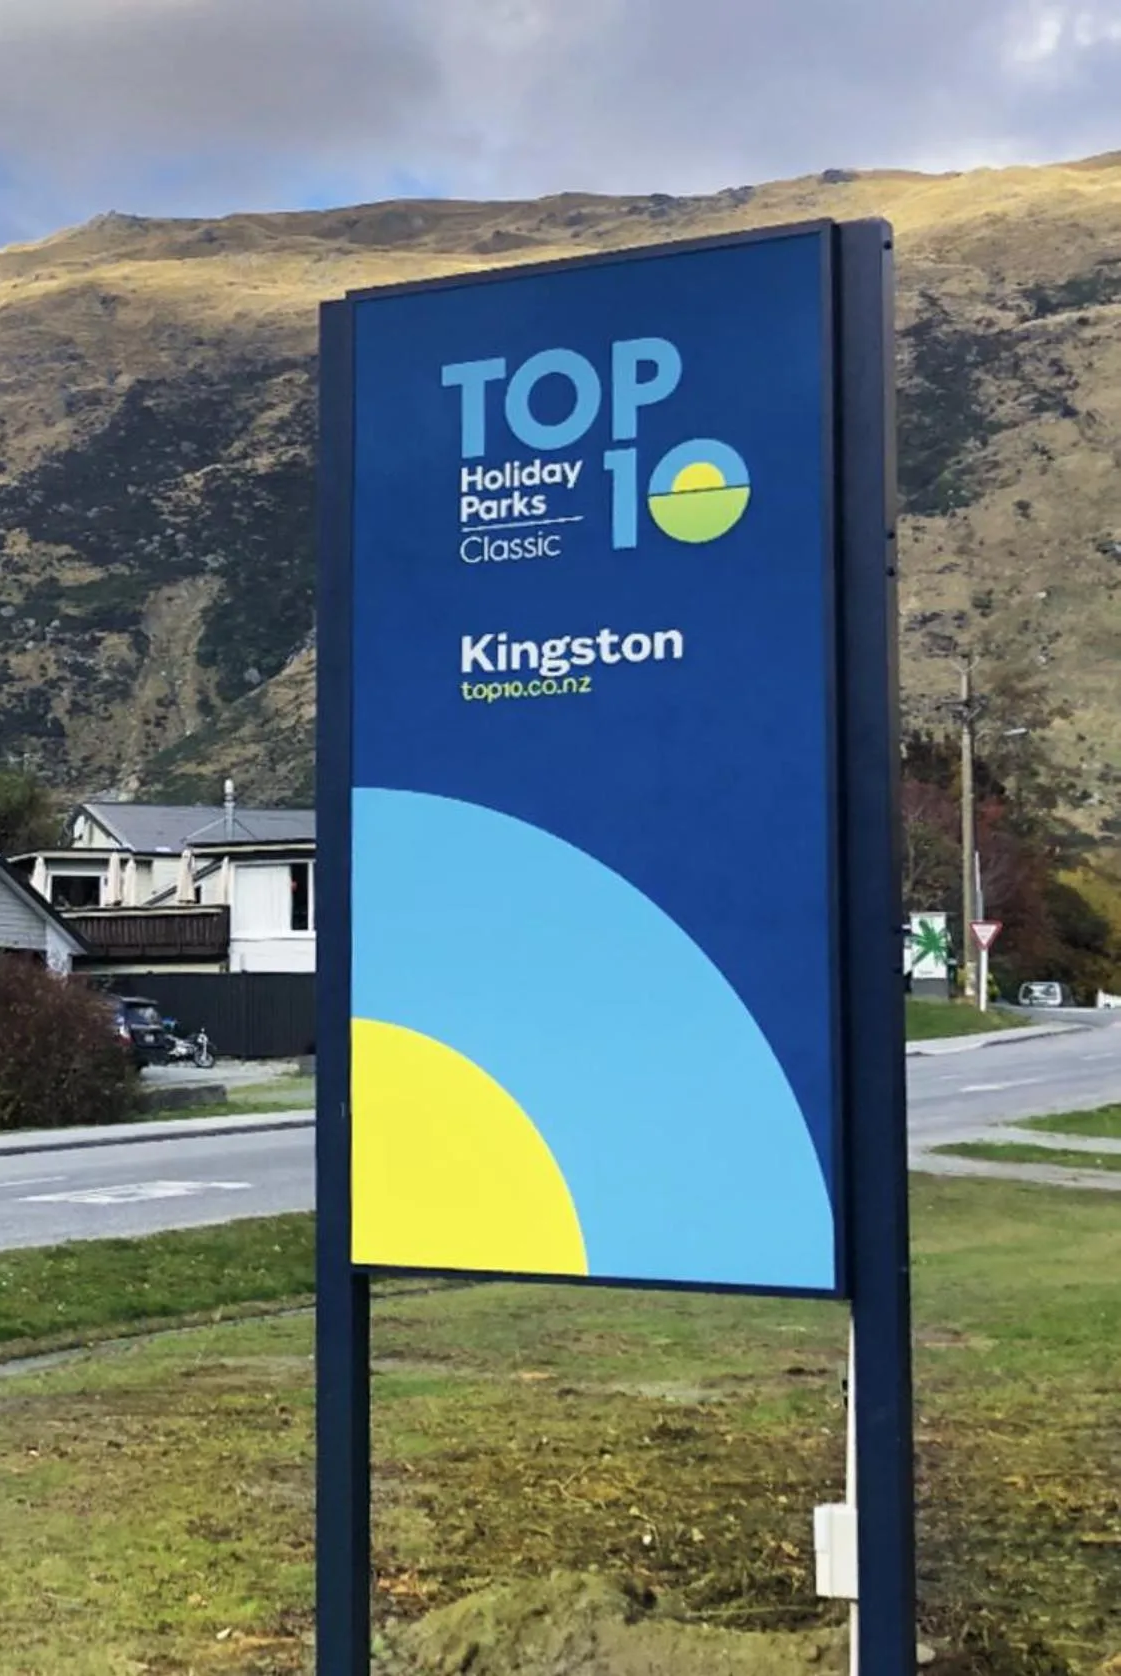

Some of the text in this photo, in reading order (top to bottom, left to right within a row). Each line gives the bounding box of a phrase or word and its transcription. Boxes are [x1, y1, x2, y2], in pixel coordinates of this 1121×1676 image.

[441, 337, 682, 459] TOP
[460, 459, 583, 493] Holiday
[603, 437, 751, 549] 10
[460, 491, 547, 523] Parks
[460, 531, 561, 563] Classic
[461, 628, 683, 677] Kingston
[461, 676, 592, 703] top10.co.nz
